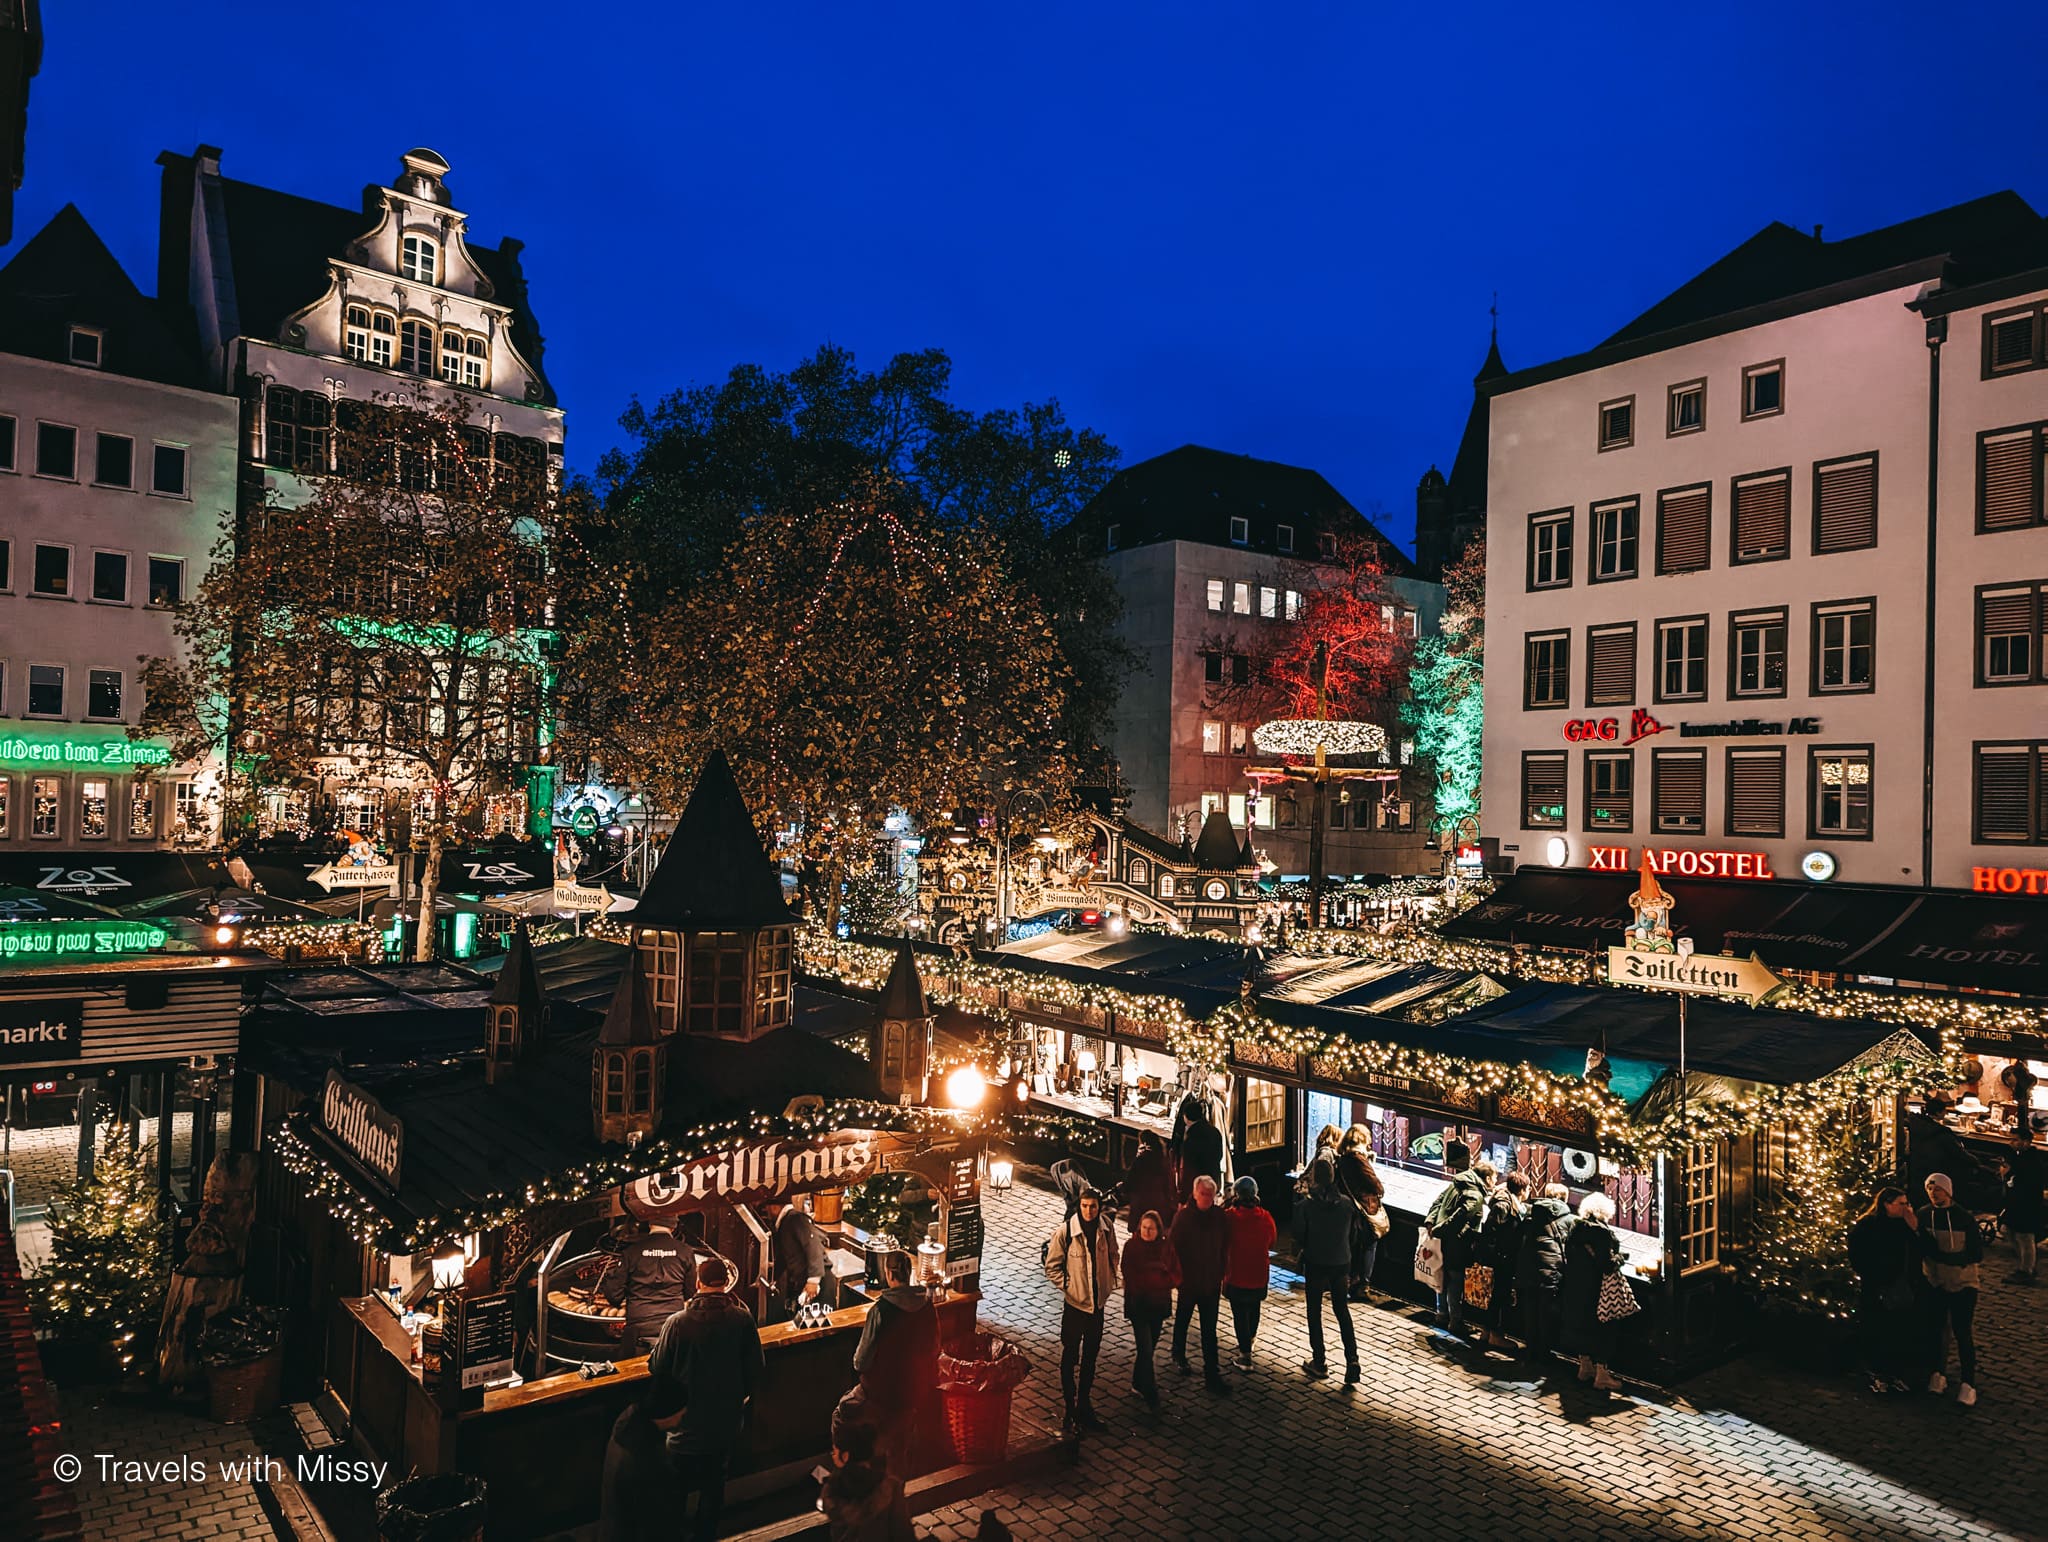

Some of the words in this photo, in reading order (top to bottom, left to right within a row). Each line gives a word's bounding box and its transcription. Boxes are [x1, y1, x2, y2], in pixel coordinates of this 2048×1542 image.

[1563, 718, 1618, 743] GAG
[1680, 719, 1783, 738] Immobilien
[1787, 717, 1823, 736] AG
[0, 739, 60, 761] lden
[65, 742, 99, 762] im
[1589, 846, 1628, 871] XII
[1638, 848, 1773, 879] APOSTEL
[329, 869, 395, 884] Futtergasse
[556, 888, 602, 905] Goldgasse
[1045, 892, 1098, 905] Wintergasse
[1906, 944, 2041, 966] HOTEL
[1625, 955, 1739, 989] Toiletten
[1964, 1029, 2012, 1042] HUTMACHER
[1369, 1073, 1410, 1091] BERNSTEIN
[324, 1080, 399, 1177] Grillhaus
[634, 1138, 872, 1207] Grillhaus
